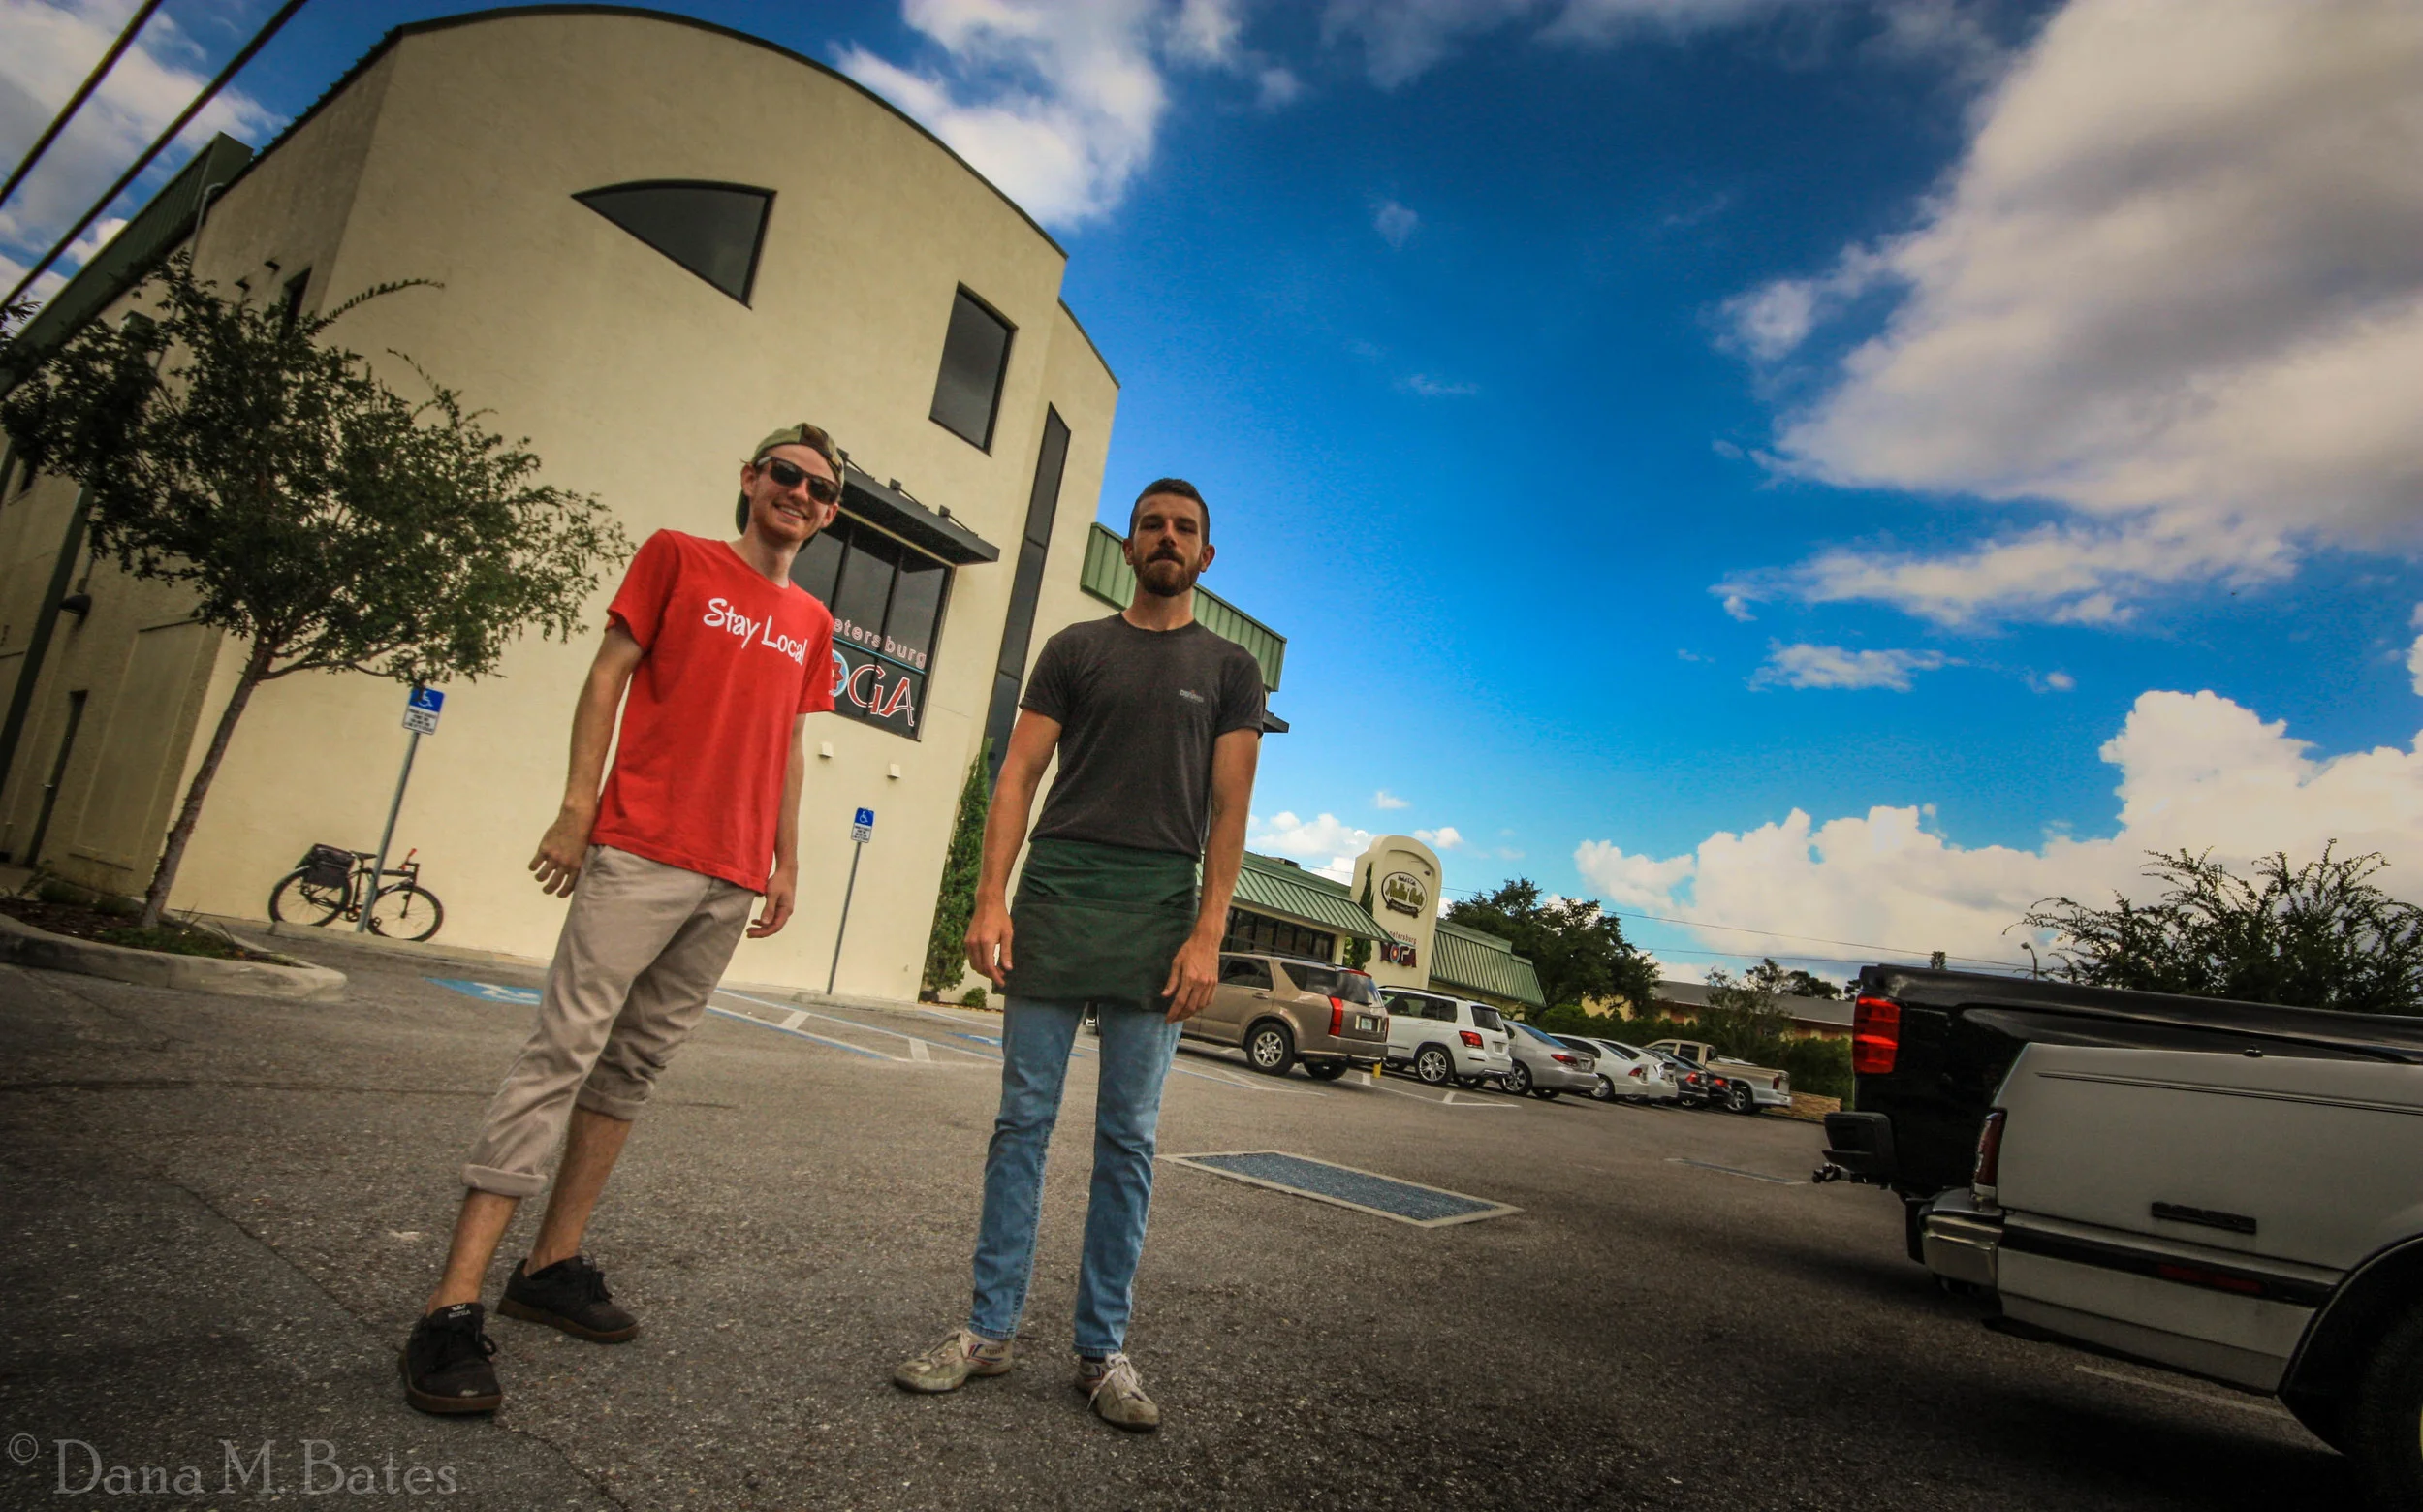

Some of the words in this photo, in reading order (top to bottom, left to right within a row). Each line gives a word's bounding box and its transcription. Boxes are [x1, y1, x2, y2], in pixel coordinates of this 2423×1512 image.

[703, 597, 760, 649] Stay
[761, 615, 808, 666] Local
[834, 618, 927, 669] etersburg
[830, 647, 915, 727] OGA
